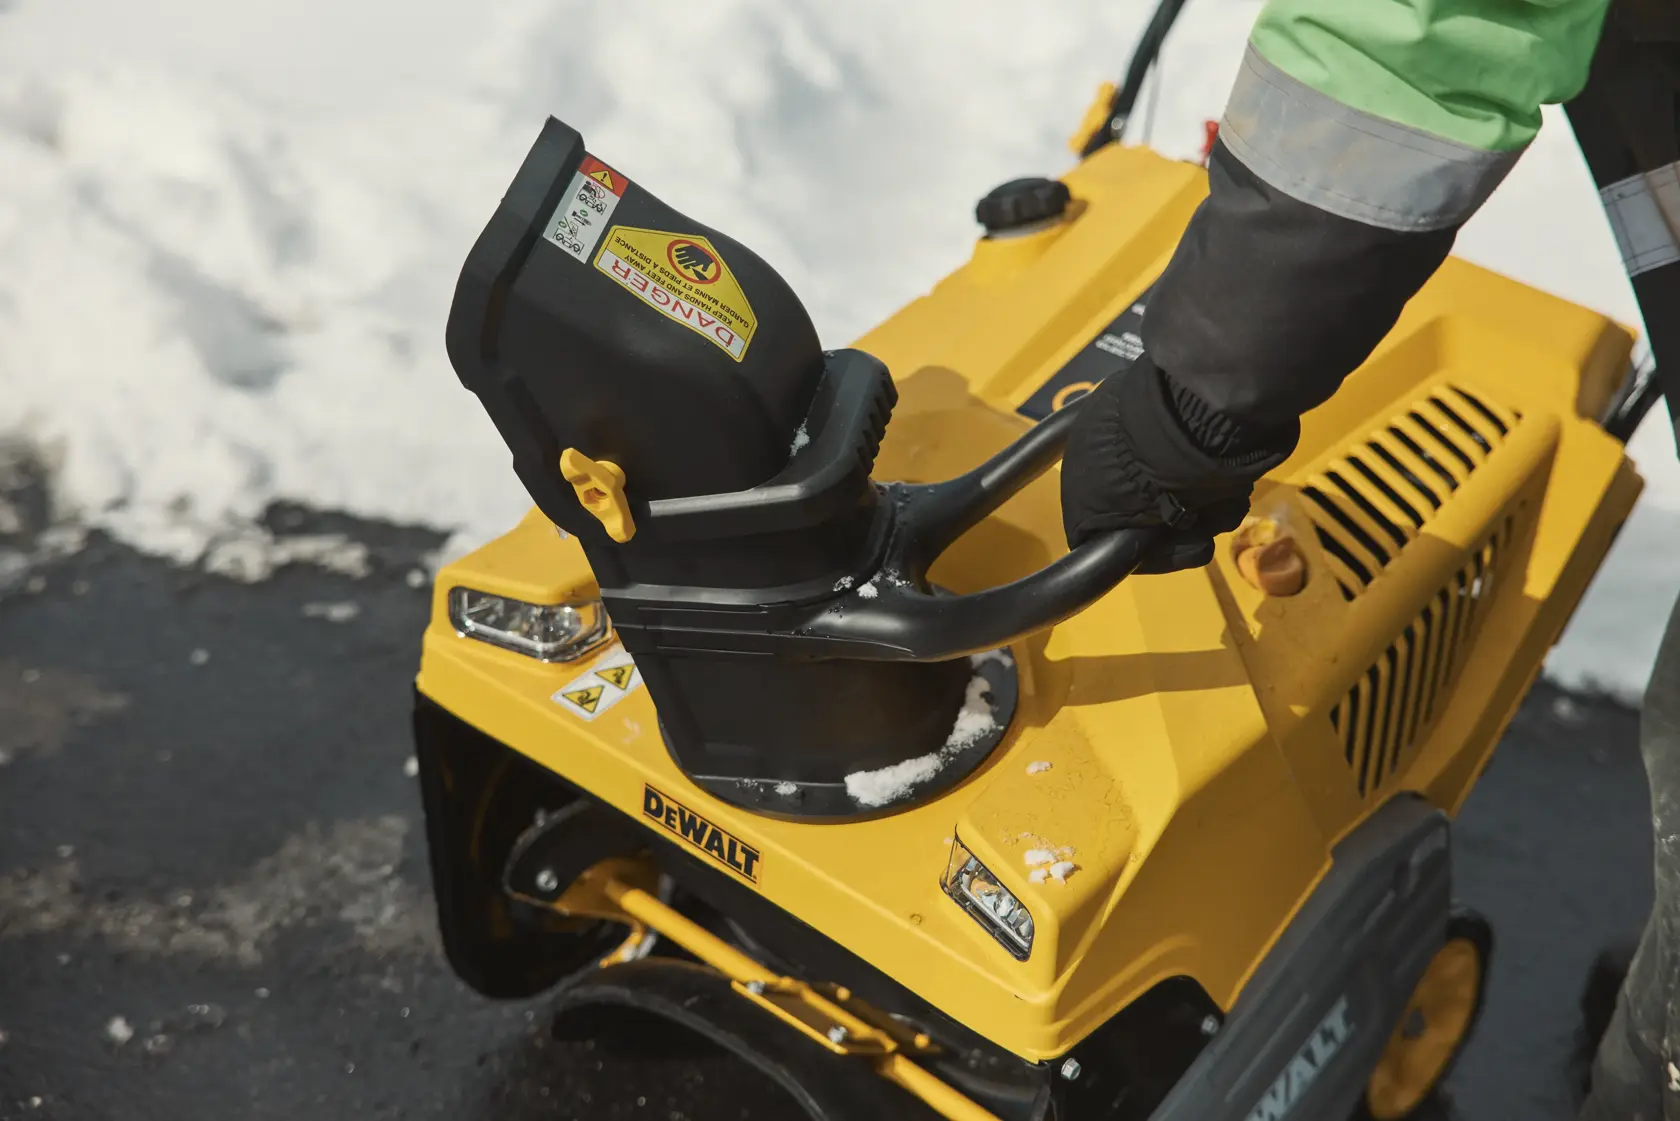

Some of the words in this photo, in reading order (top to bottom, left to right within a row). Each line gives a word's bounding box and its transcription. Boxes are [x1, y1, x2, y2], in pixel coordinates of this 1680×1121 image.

[614, 236, 652, 265] DISTANCE
[624, 254, 646, 271] AWAY
[646, 269, 666, 285] FEET
[659, 266, 682, 285] PIEDS
[666, 283, 683, 296] AND
[682, 282, 694, 291] ET
[612, 259, 734, 346] DANGER
[684, 293, 712, 311] HANDS
[694, 288, 720, 306] MAINS
[712, 310, 733, 326] KEEP
[719, 302, 749, 328] GARDER
